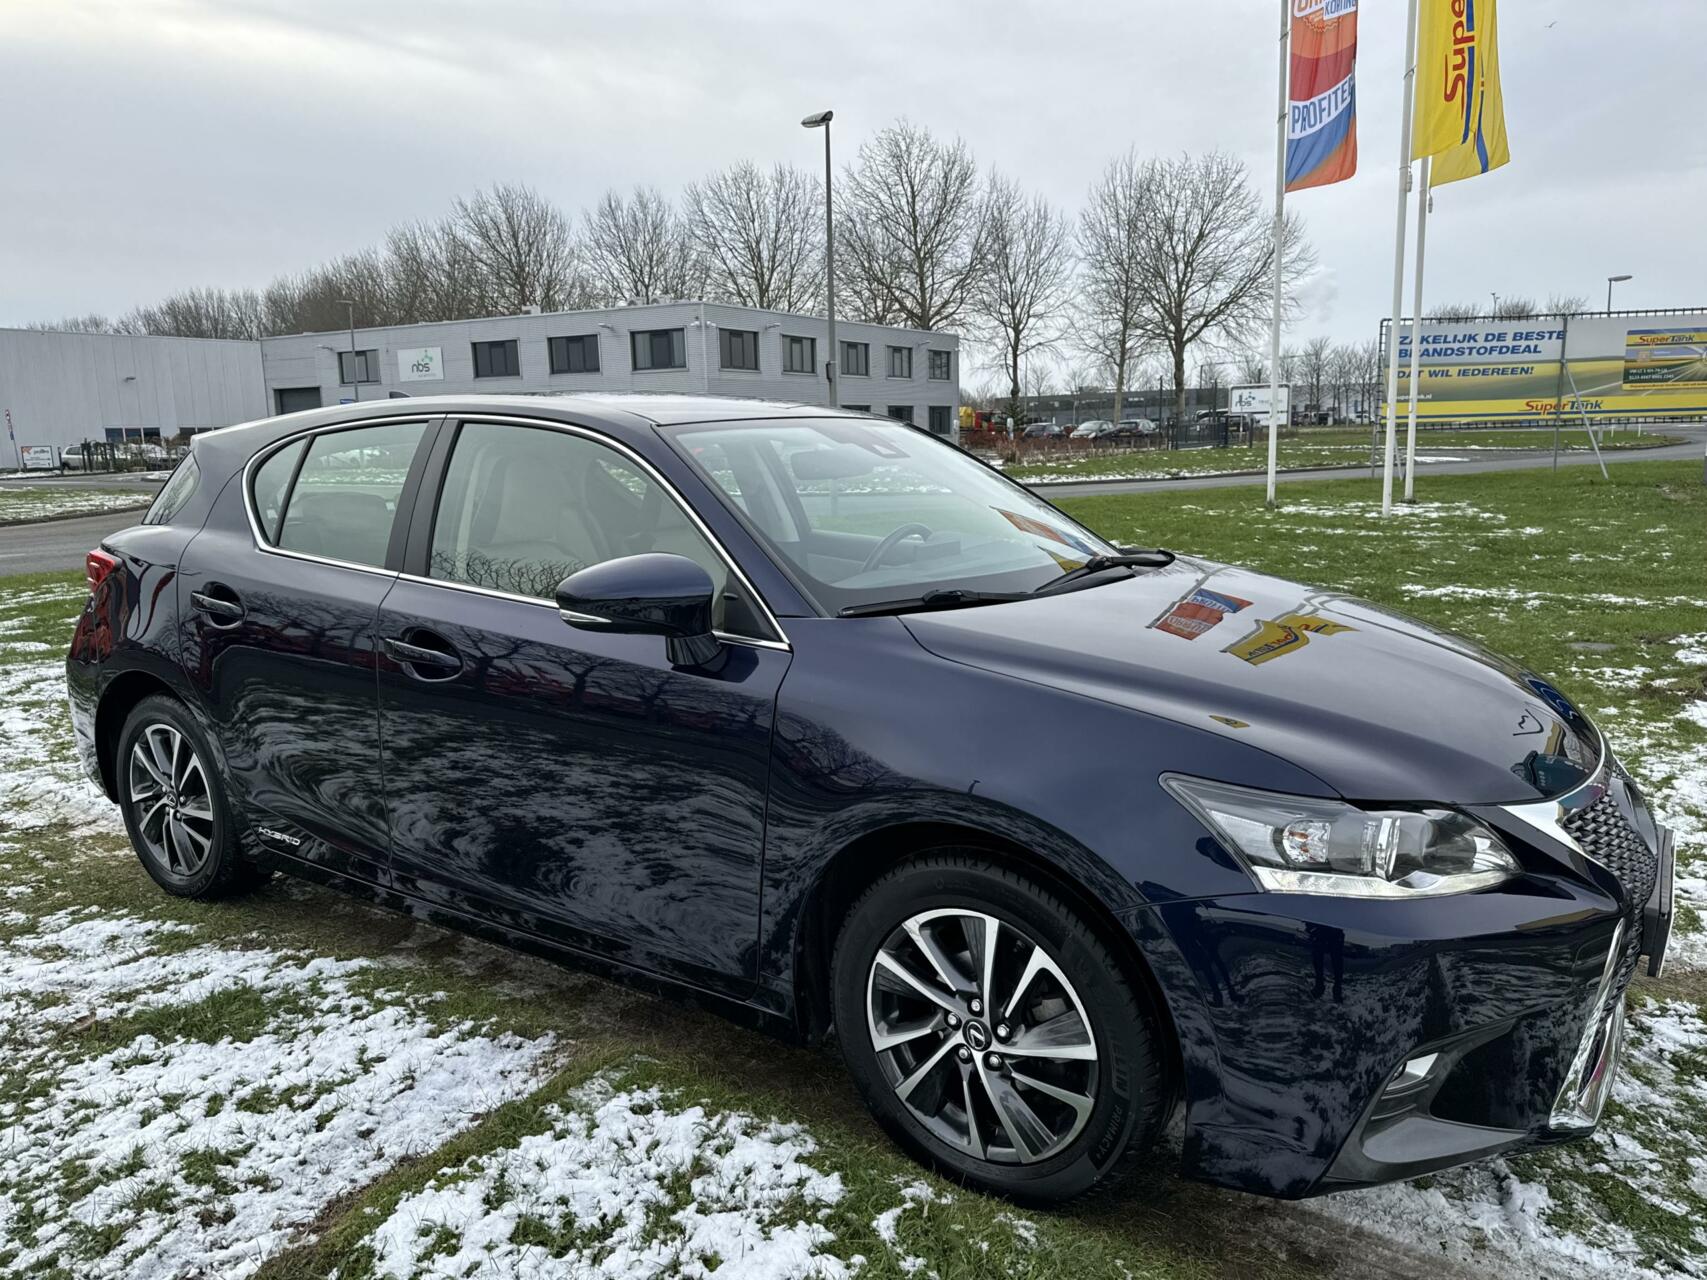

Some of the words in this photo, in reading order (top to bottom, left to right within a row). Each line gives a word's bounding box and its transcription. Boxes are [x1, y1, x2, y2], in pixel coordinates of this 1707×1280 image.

[1484, 332, 1507, 342] DE
[1512, 330, 1567, 341] BESTE
[1637, 335, 1695, 345] SuperTank
[411, 360, 430, 373] nbs
[1428, 369, 1452, 377] WIL
[1457, 366, 1534, 377] IEDEREEN!
